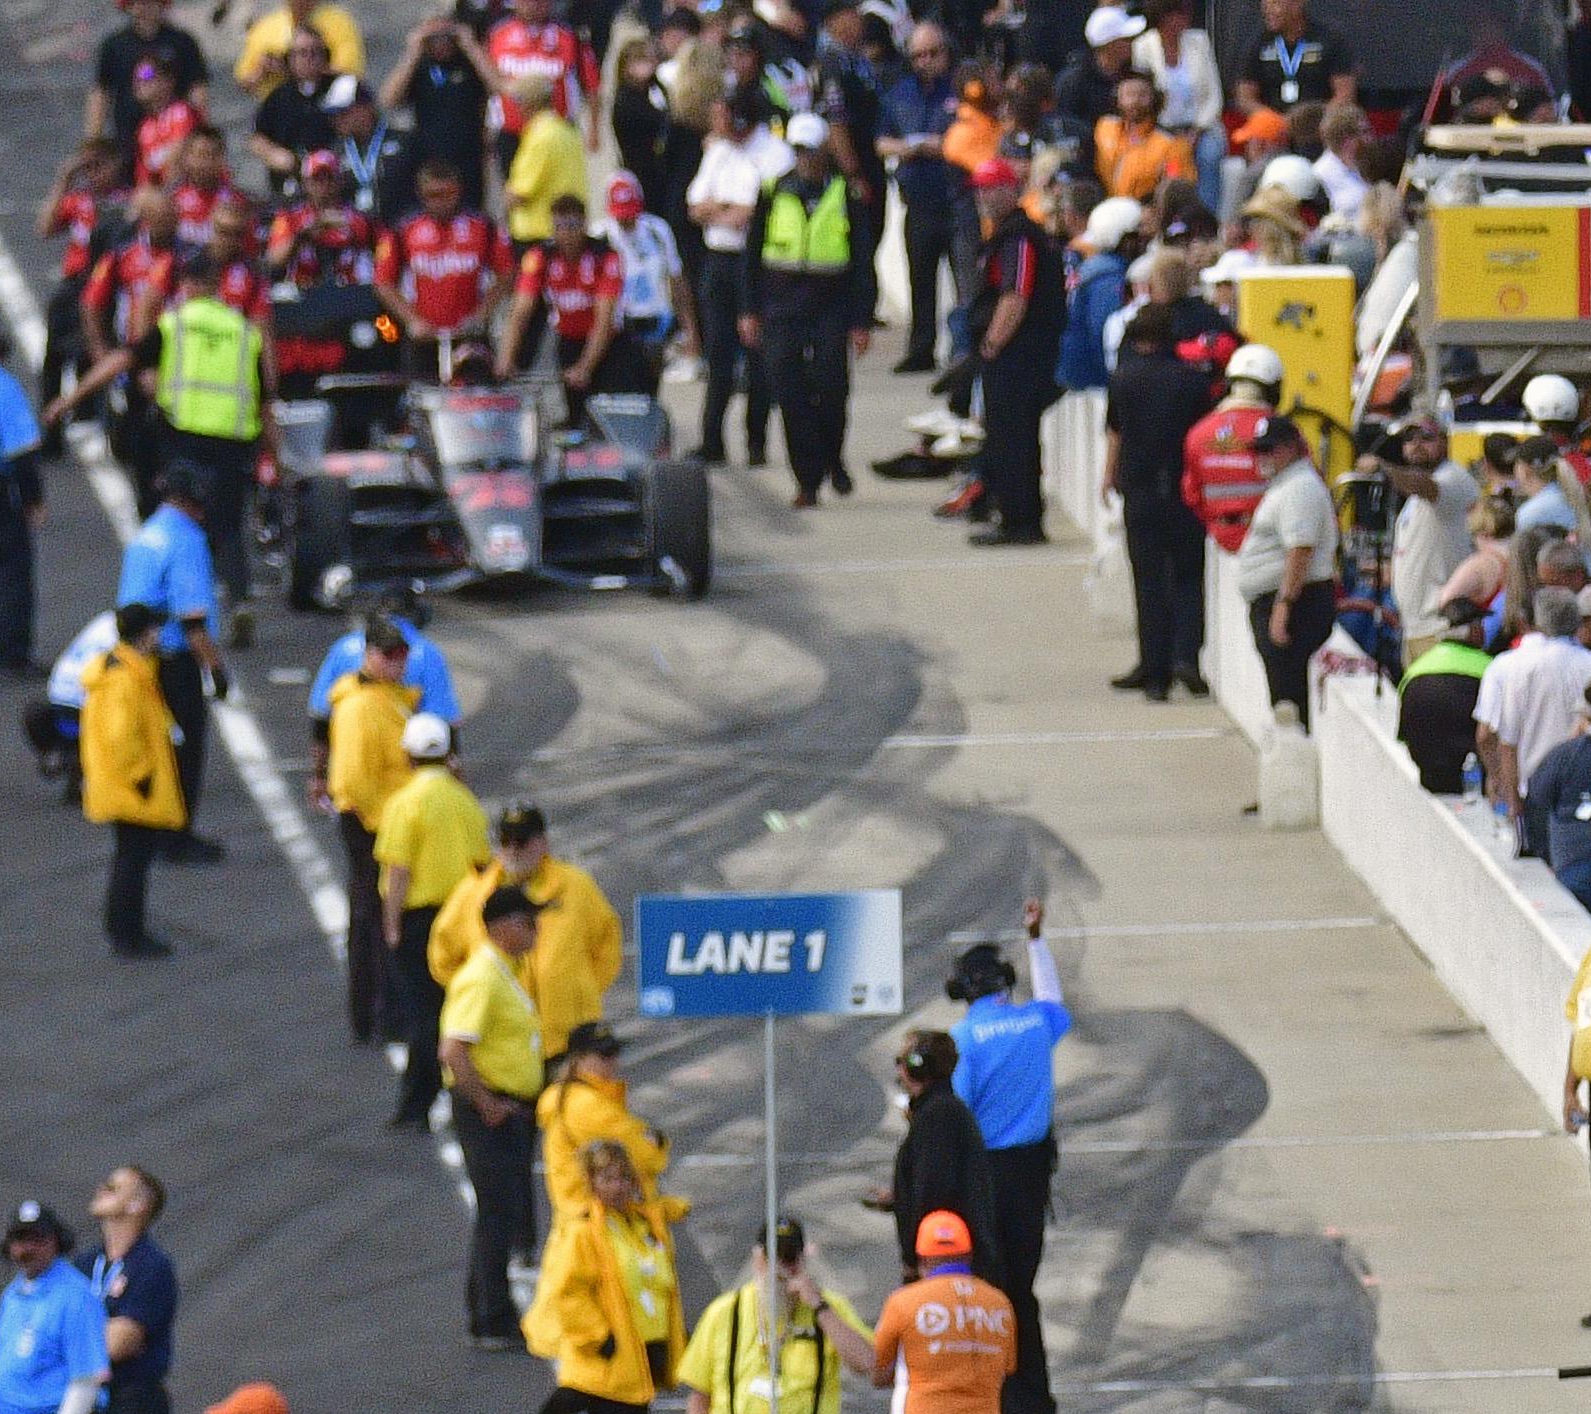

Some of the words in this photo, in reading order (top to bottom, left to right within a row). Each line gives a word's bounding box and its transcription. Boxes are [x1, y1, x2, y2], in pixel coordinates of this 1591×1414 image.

[665, 928, 796, 976] LANE
[804, 928, 828, 973] 1
[954, 1304, 1010, 1338] PNC
